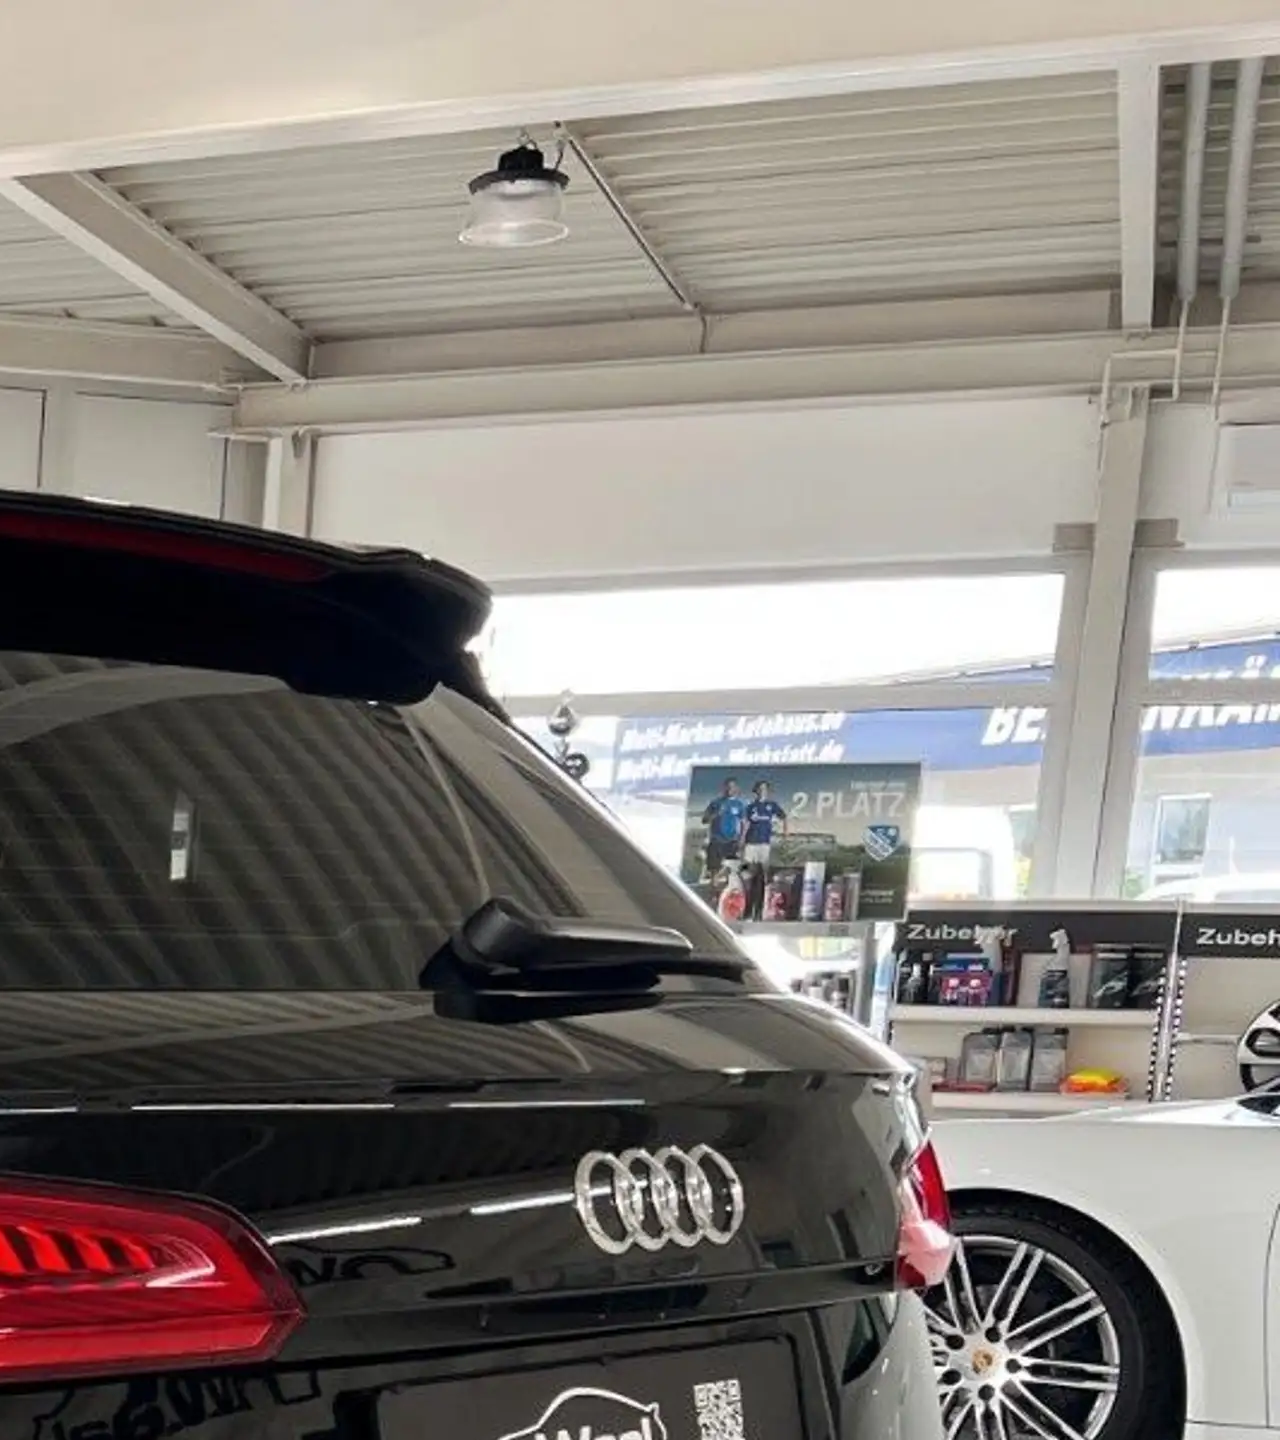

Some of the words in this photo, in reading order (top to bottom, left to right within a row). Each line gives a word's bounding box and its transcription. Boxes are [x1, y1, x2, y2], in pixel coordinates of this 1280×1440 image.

[792, 791, 810, 818] 2
[816, 791, 904, 819] PLATZ
[907, 923, 1018, 946] Zuber
